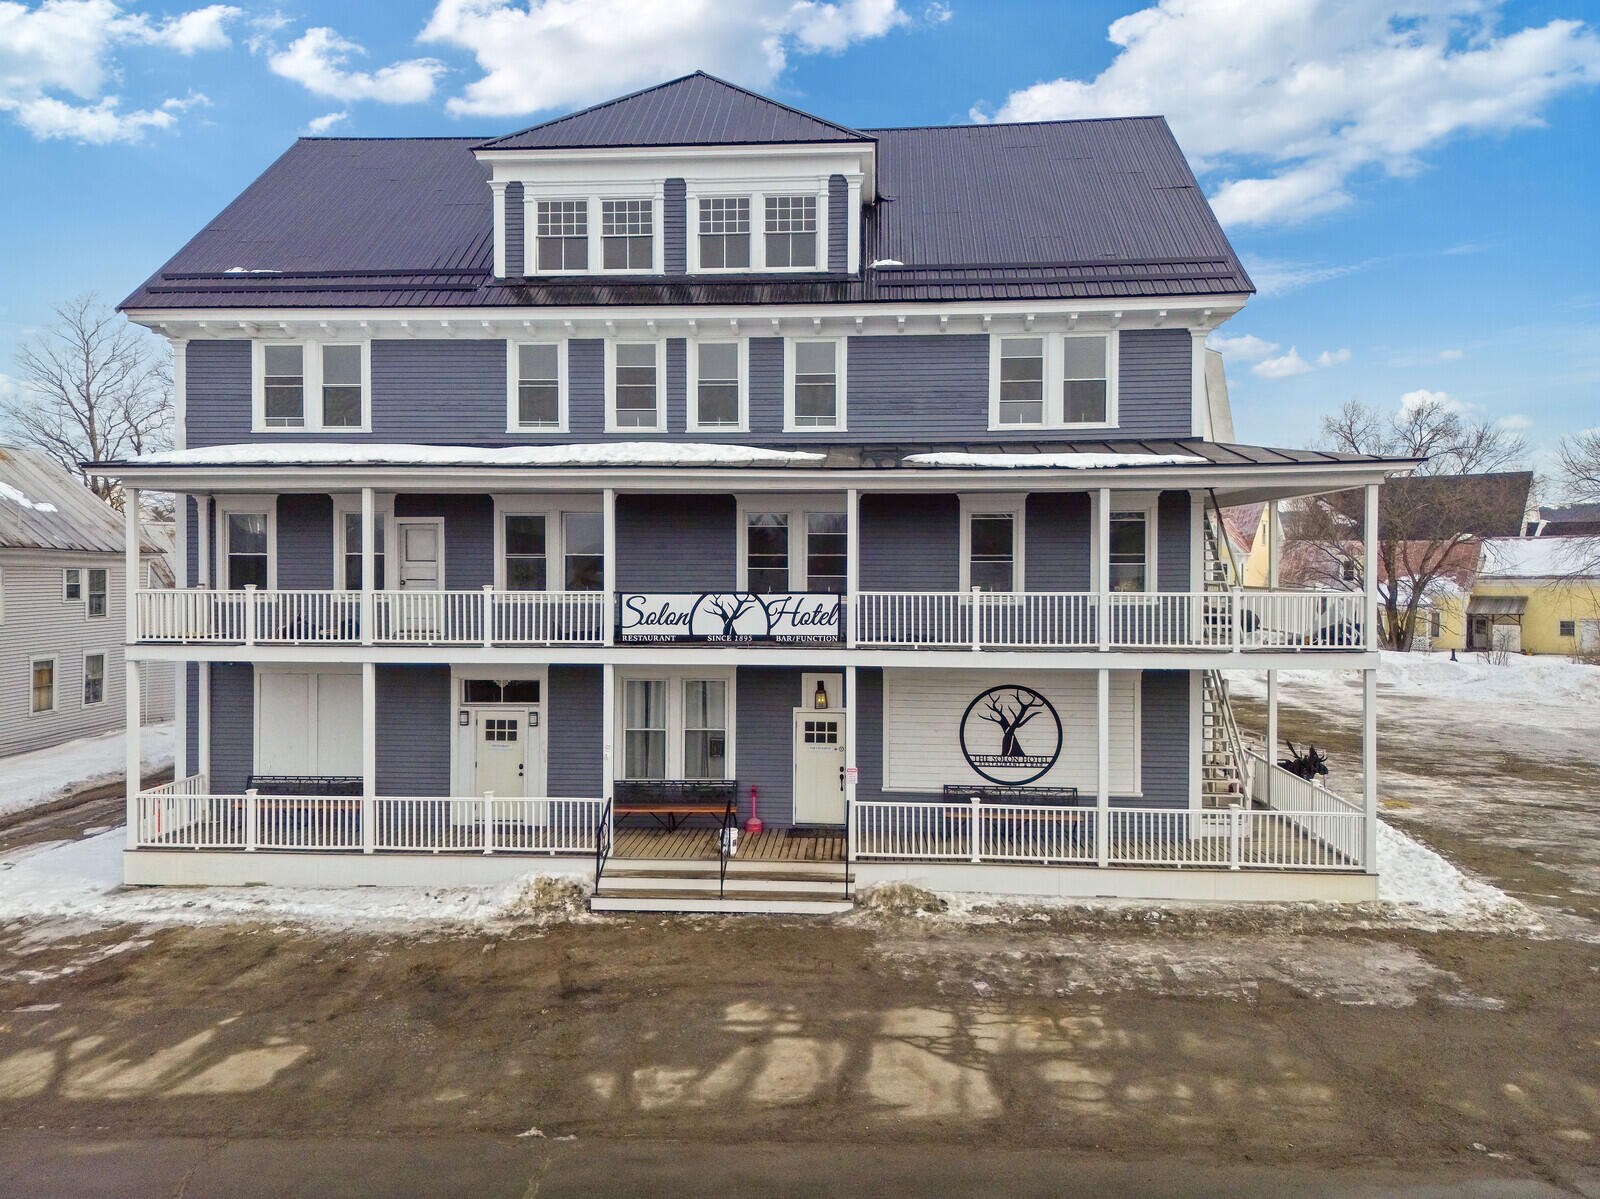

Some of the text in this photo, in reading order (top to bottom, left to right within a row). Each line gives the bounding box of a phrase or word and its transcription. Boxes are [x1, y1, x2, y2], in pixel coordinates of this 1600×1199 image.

[622, 595, 839, 629] Solon Hotel
[992, 755, 1019, 763] SOLON
